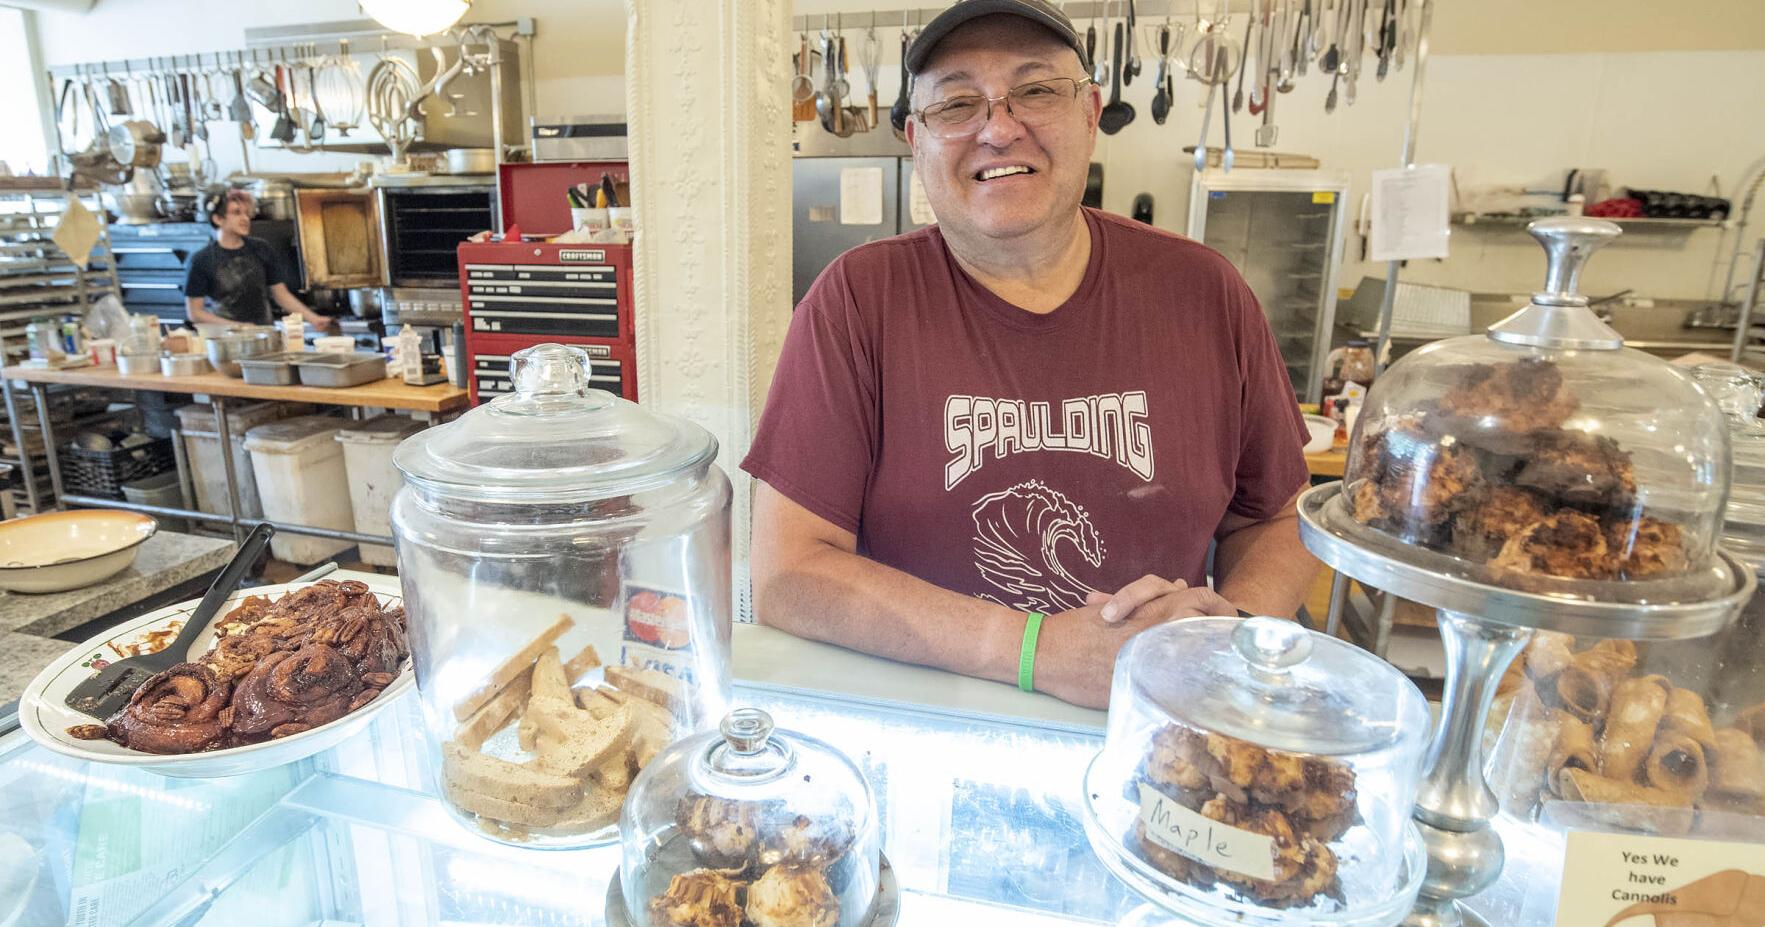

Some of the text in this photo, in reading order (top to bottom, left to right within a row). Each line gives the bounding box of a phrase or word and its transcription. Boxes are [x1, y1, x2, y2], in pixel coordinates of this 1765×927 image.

[562, 251, 603, 260] CRAFTSMAN
[945, 390, 1155, 491] SPAULDING
[1150, 799, 1232, 857] Maple
[1622, 851, 1679, 867] Yes We
[1628, 871, 1666, 885] have
[1611, 889, 1677, 905] Cannolis
